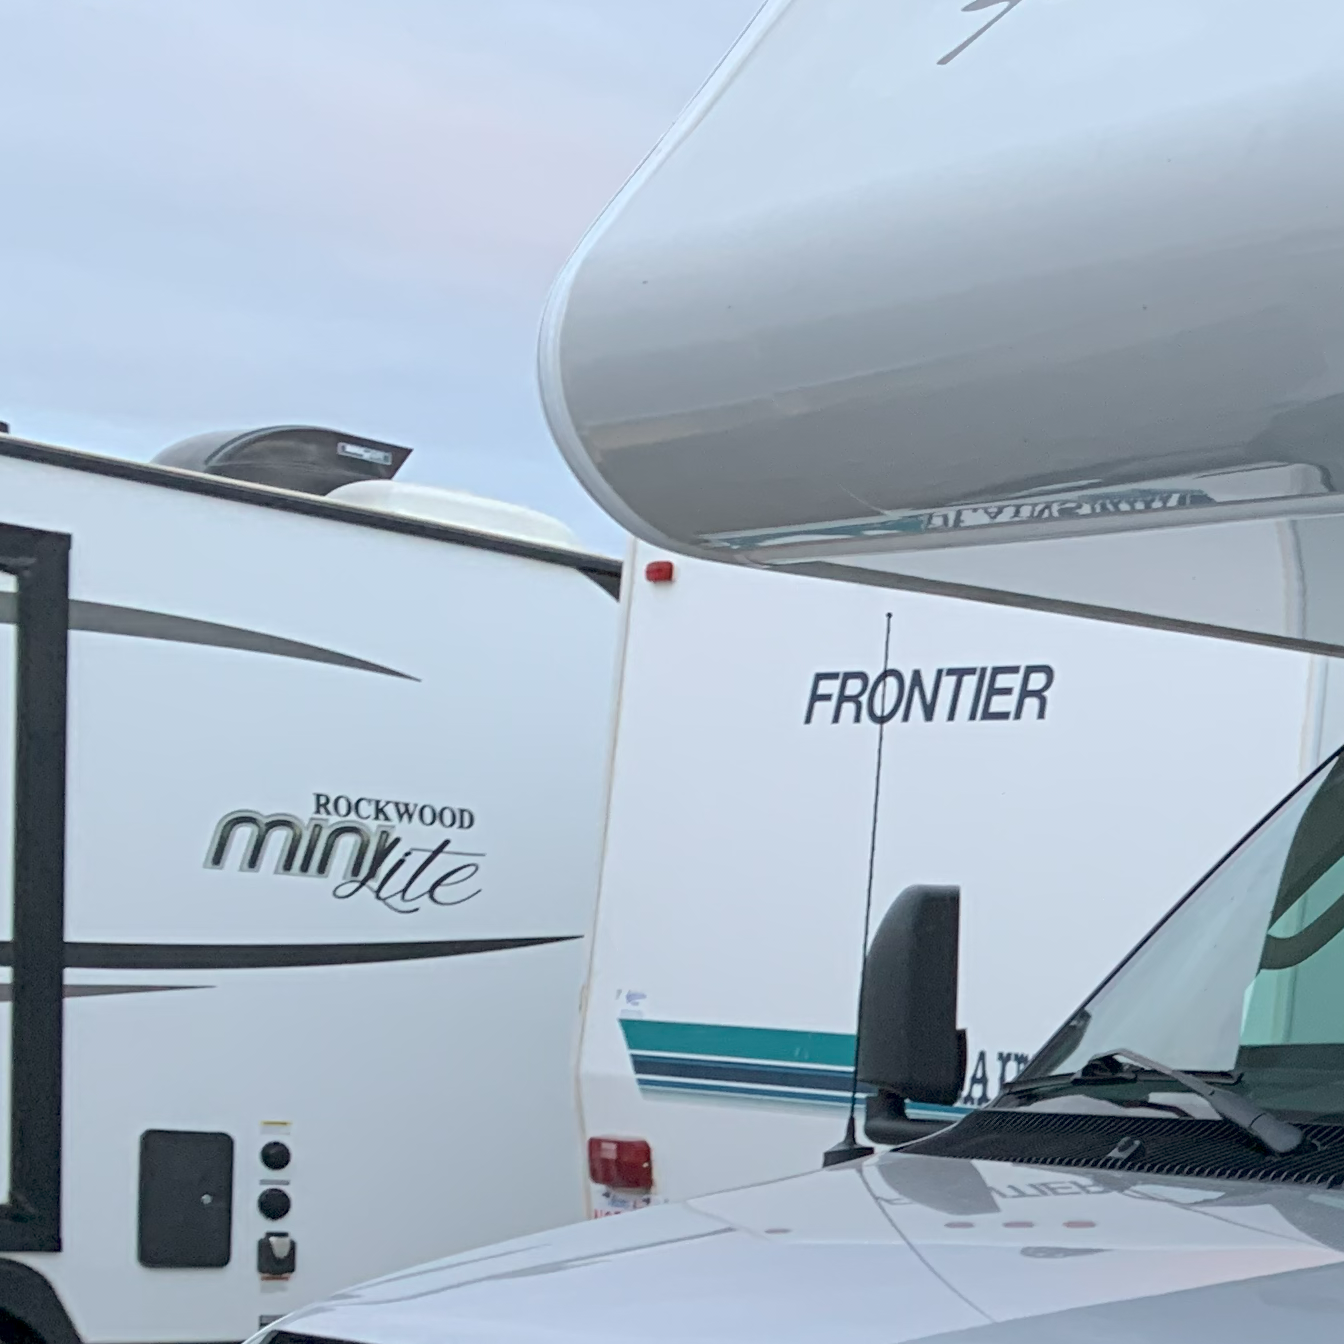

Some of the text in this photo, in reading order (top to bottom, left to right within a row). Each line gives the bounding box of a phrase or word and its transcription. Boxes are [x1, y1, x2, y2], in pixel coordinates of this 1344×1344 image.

[804, 664, 1054, 725] FRONTIER
[312, 793, 475, 829] ROCKWOOD
[203, 809, 395, 882] mini
